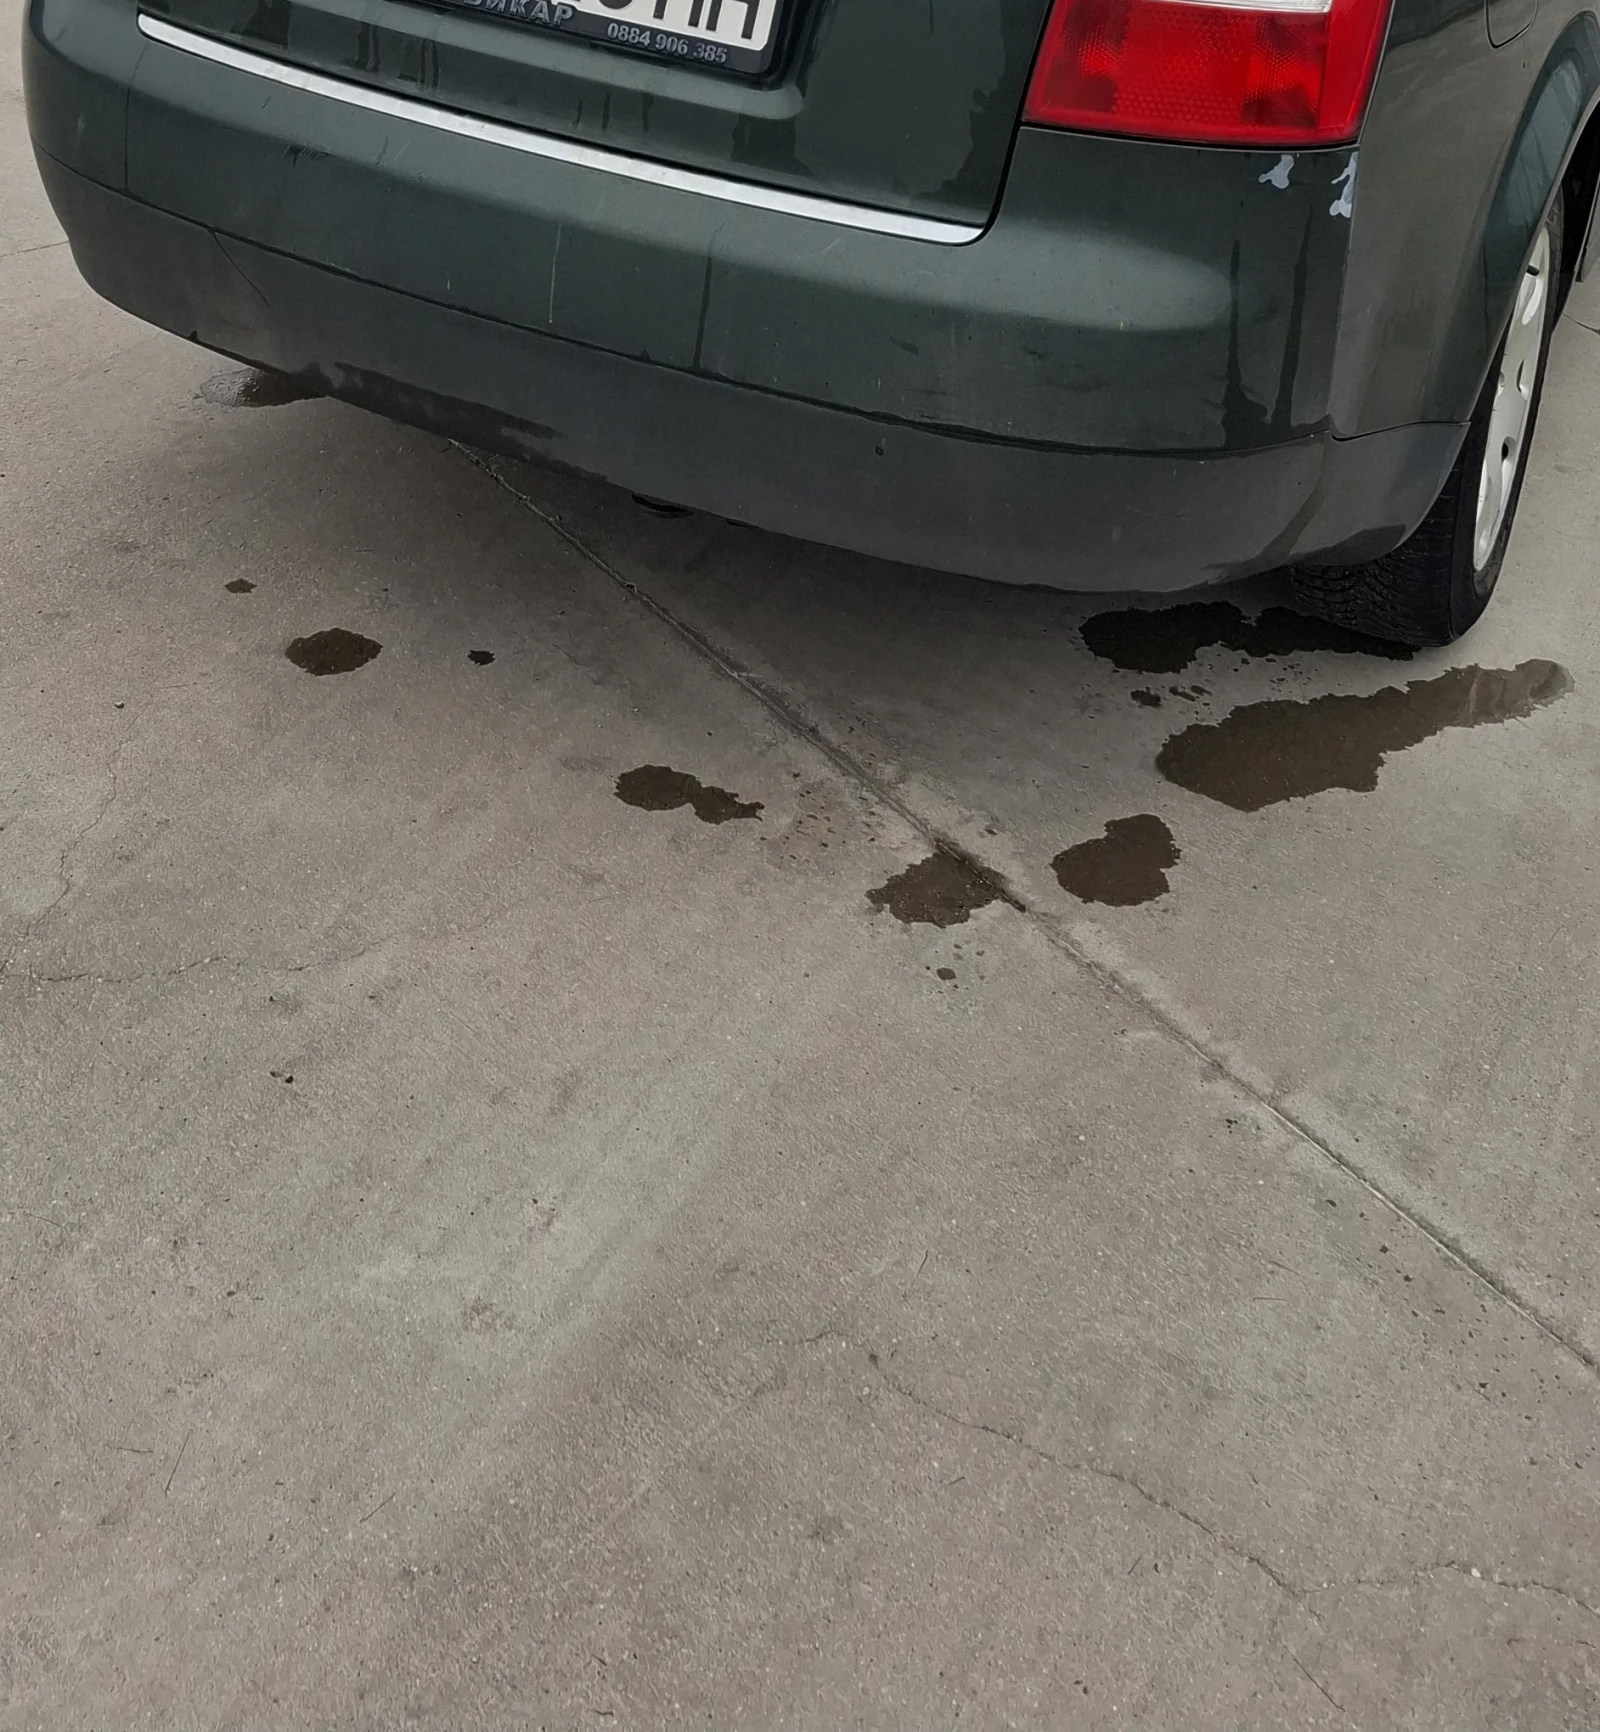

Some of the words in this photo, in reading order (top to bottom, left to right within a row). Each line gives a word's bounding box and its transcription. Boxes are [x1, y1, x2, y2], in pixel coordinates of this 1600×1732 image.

[607, 23, 651, 47] 0884
[655, 35, 688, 56] 906
[693, 43, 727, 64] 385
